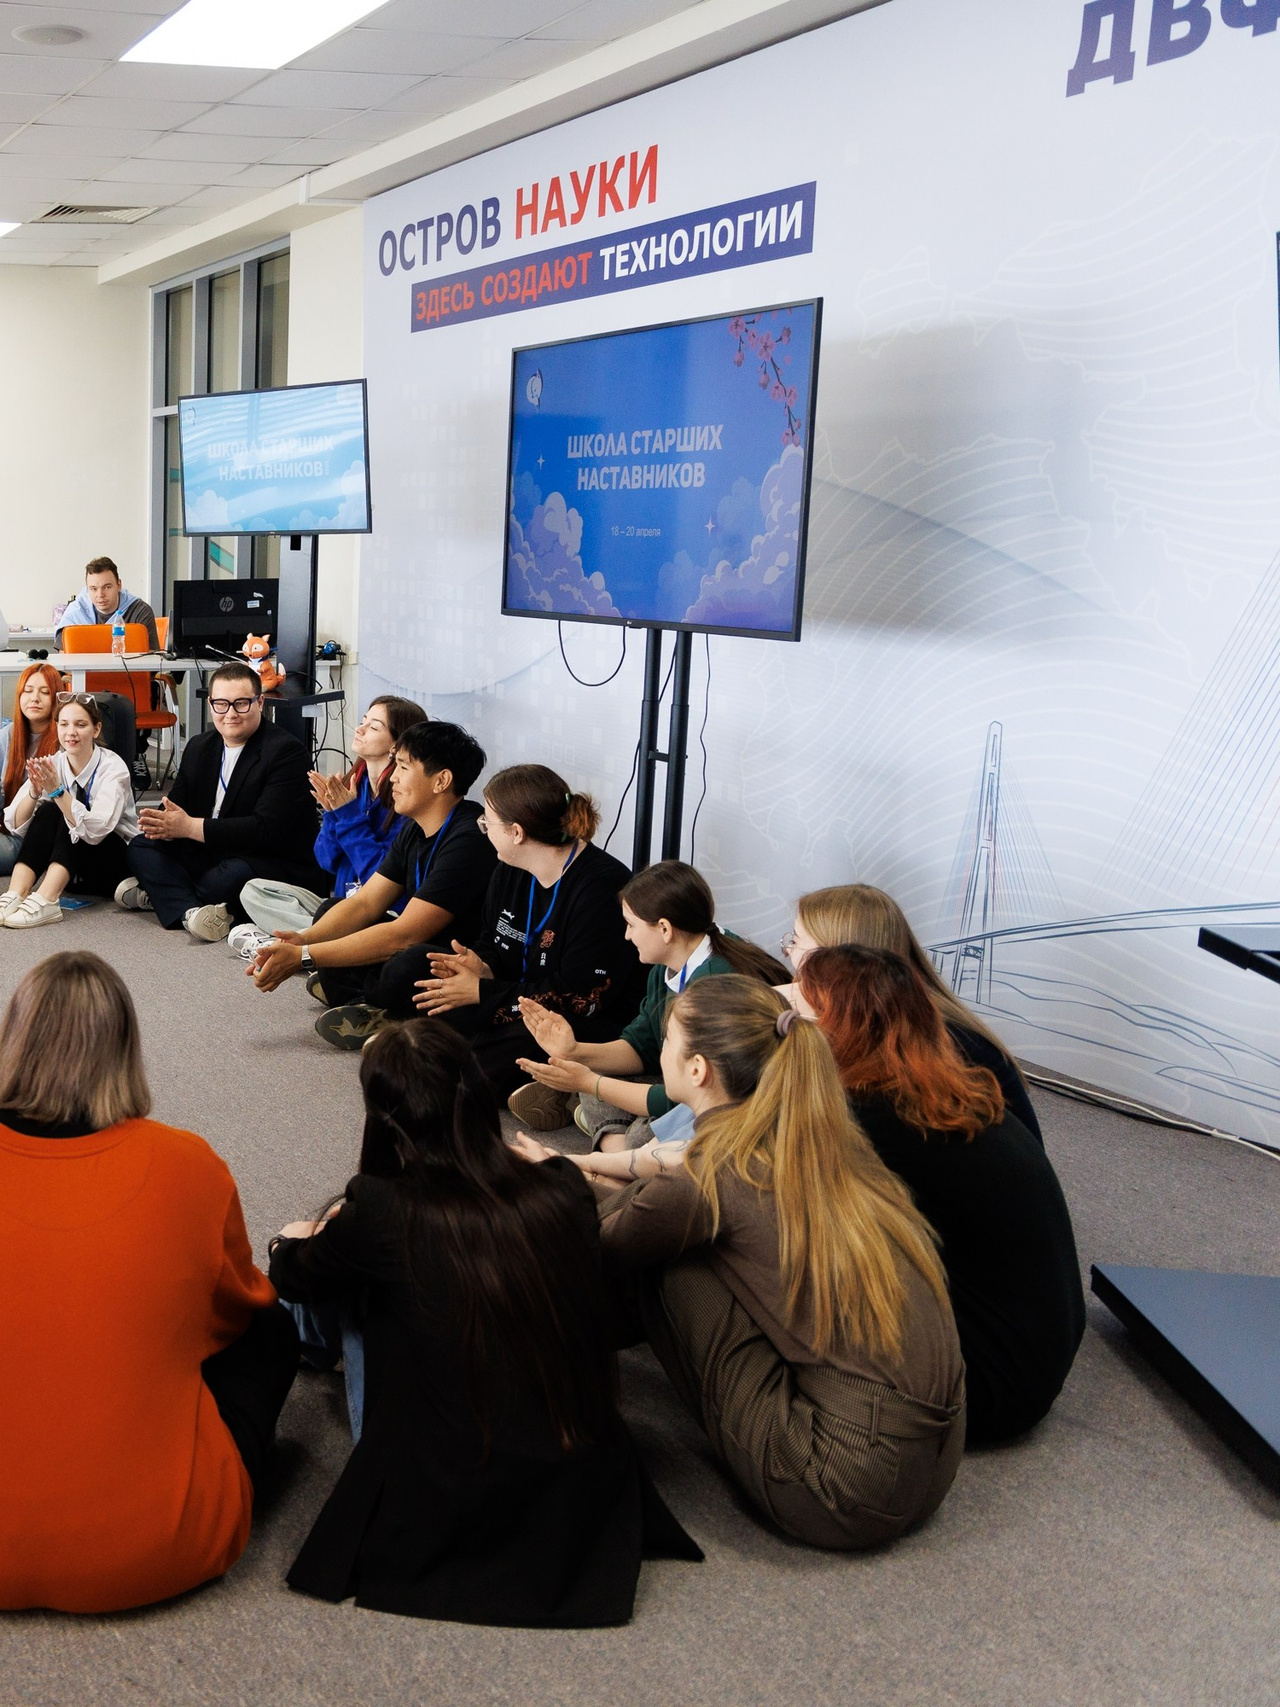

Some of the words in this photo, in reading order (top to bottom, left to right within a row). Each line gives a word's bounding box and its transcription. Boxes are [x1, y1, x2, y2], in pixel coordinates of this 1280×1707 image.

[378, 196, 501, 277] ОСТРОВ
[515, 144, 658, 240] НАУКИ
[415, 281, 474, 324] ЗДЕСЬ
[480, 251, 593, 305] СОЗДАЮТ
[600, 200, 803, 280] ТЕХНОЛОГИИ
[567, 432, 628, 459] ШКОЛА
[631, 424, 724, 455] СТАРШИХ
[220, 460, 323, 481] НАСТАВНИКОВ
[577, 462, 706, 491] НАСТАВНИКОВ
[611, 526, 619, 536] 18
[626, 526, 634, 537] 20
[636, 528, 661, 538] апреля
[219, 596, 235, 612] hp
